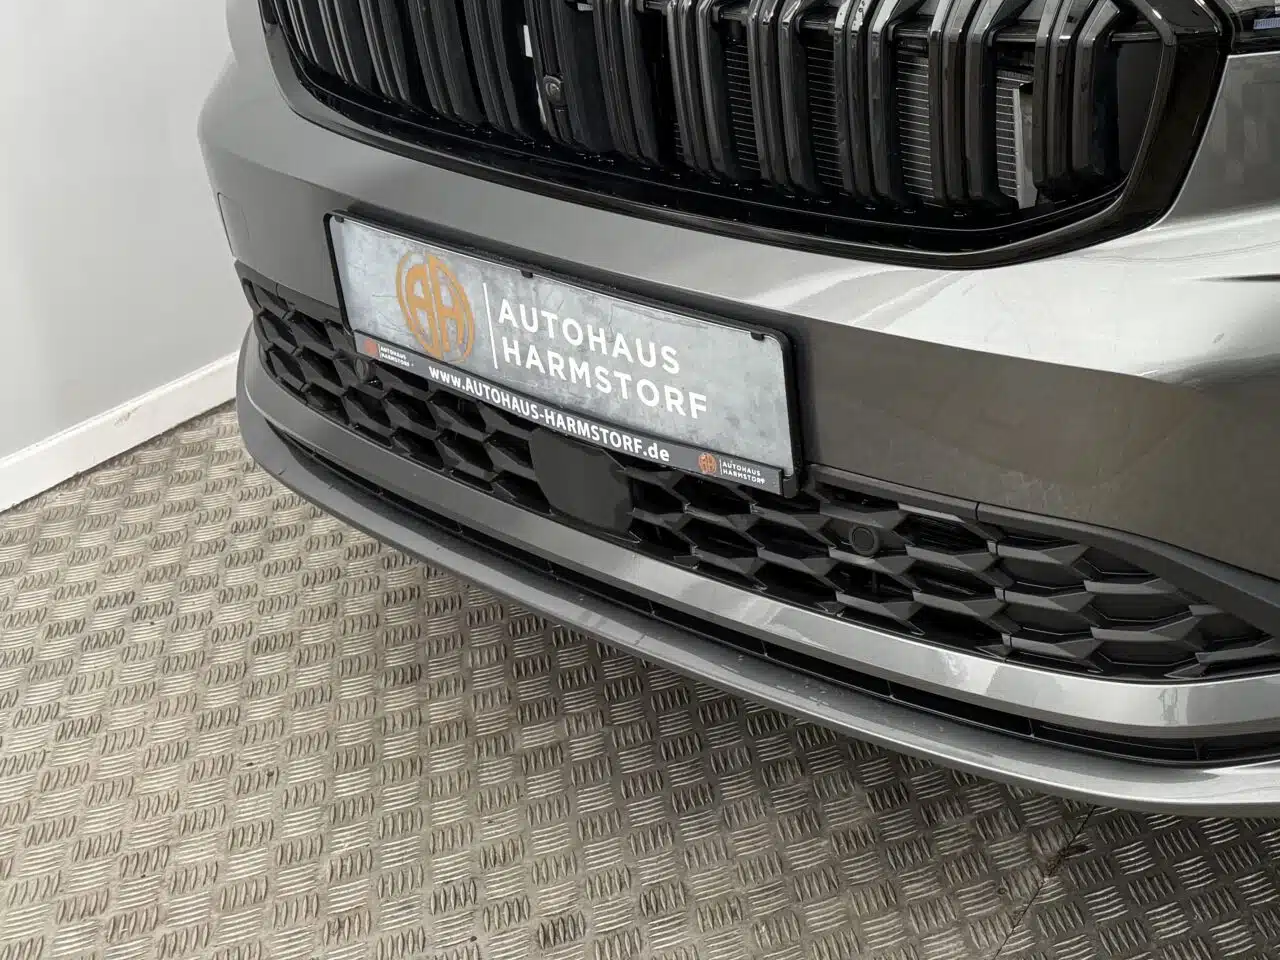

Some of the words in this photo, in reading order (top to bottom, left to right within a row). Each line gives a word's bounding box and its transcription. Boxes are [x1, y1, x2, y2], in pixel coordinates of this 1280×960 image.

[498, 298, 681, 374] AUTOHAUS
[428, 365, 670, 462] www.AUTOHAUS-HARMSTORF.de
[501, 336, 708, 420] HARMSTORF
[722, 461, 761, 476] AUTOHAUS
[722, 468, 766, 485] HARMSTORF
